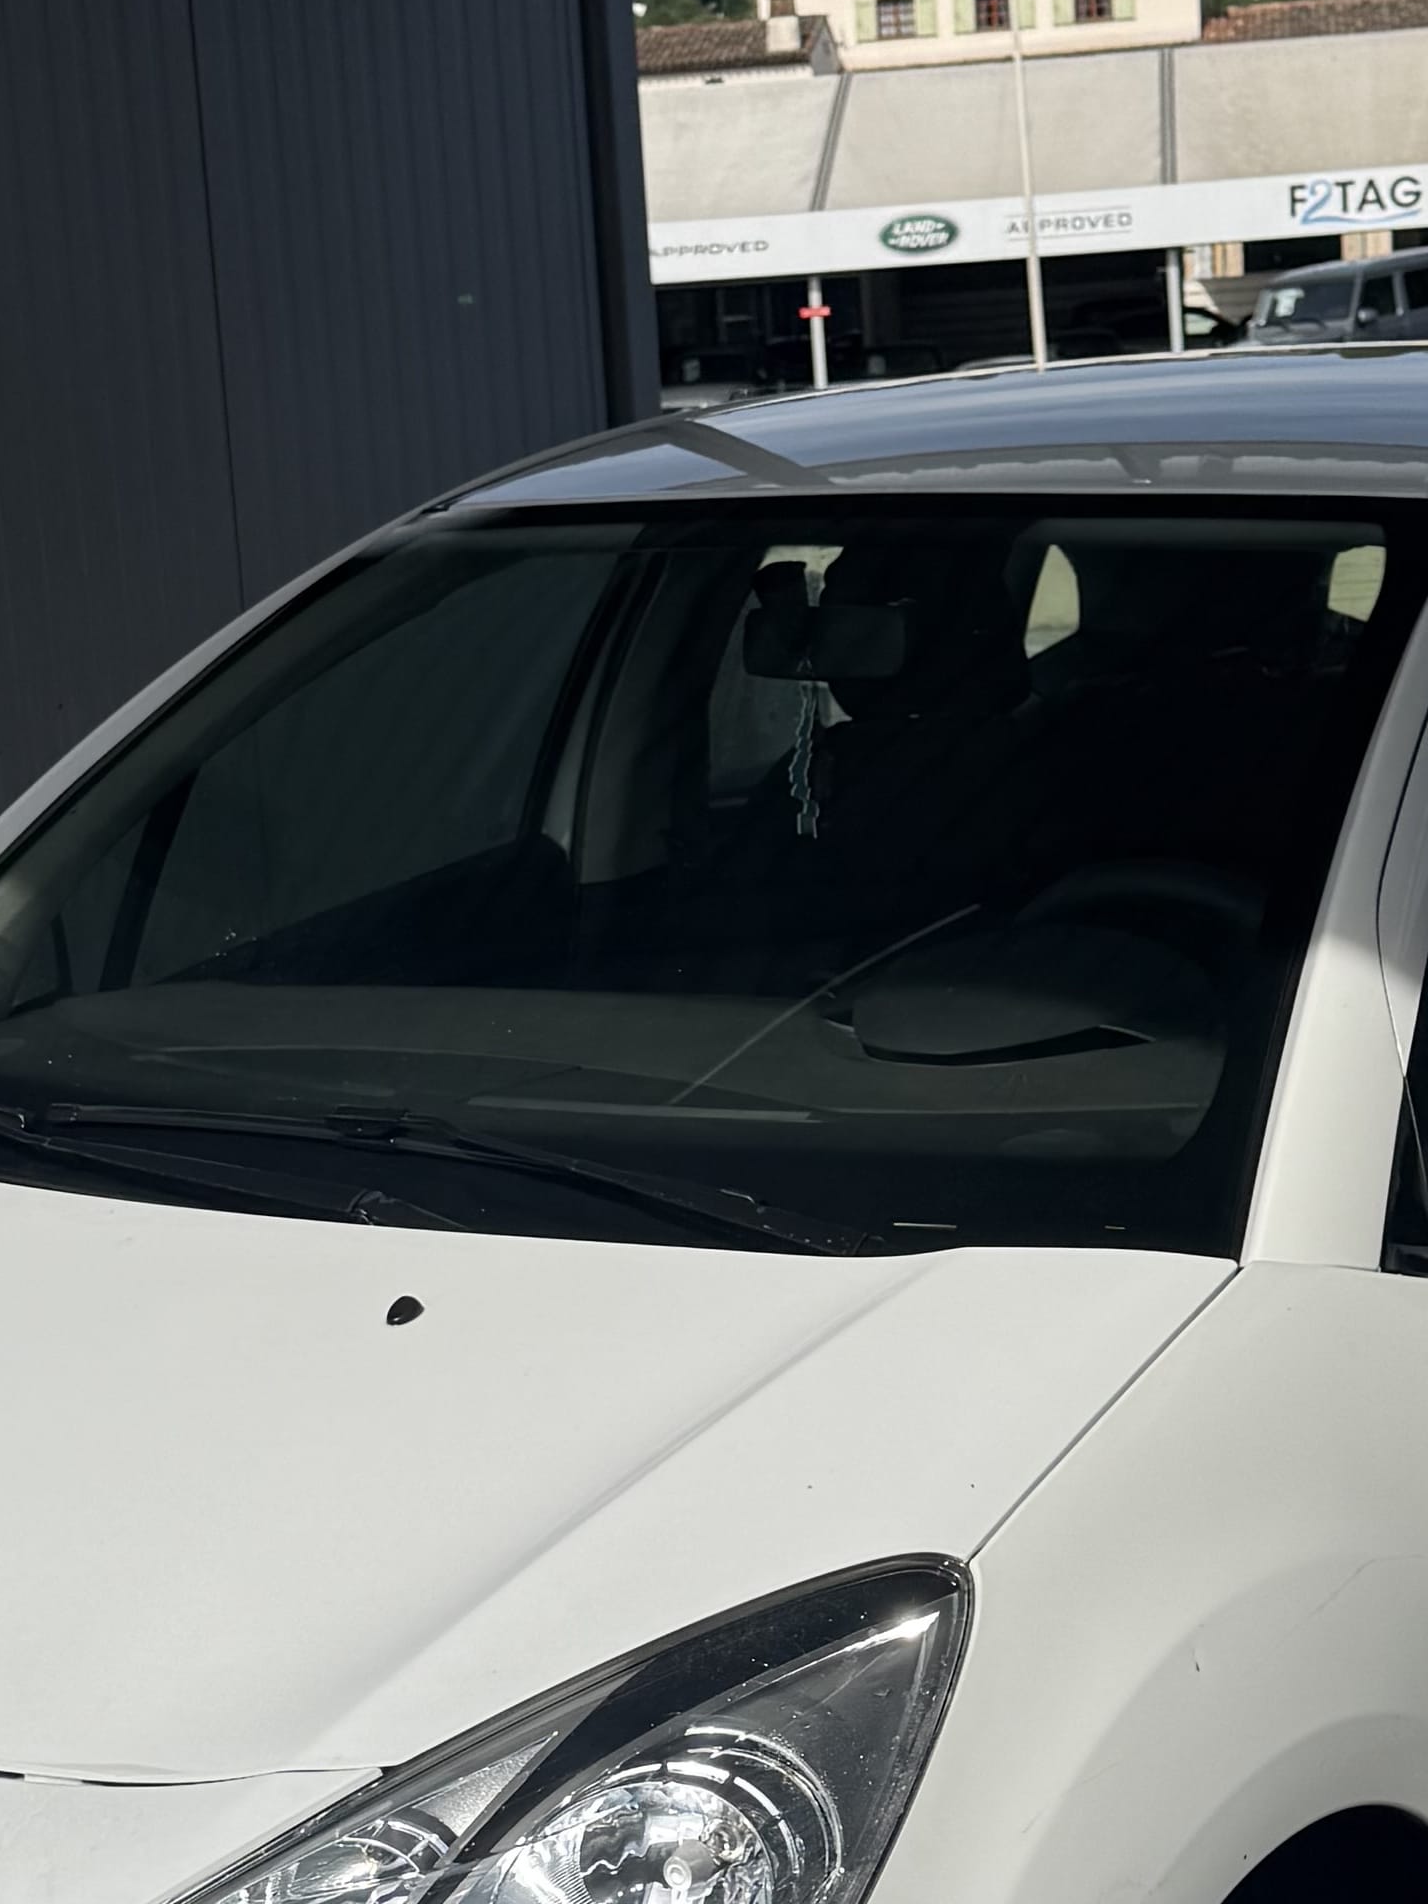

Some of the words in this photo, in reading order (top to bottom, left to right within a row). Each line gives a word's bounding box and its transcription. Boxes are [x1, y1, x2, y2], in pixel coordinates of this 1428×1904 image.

[1290, 176, 1423, 224] F2TAG
[892, 219, 938, 234] LAND
[897, 232, 949, 248] ROVER
